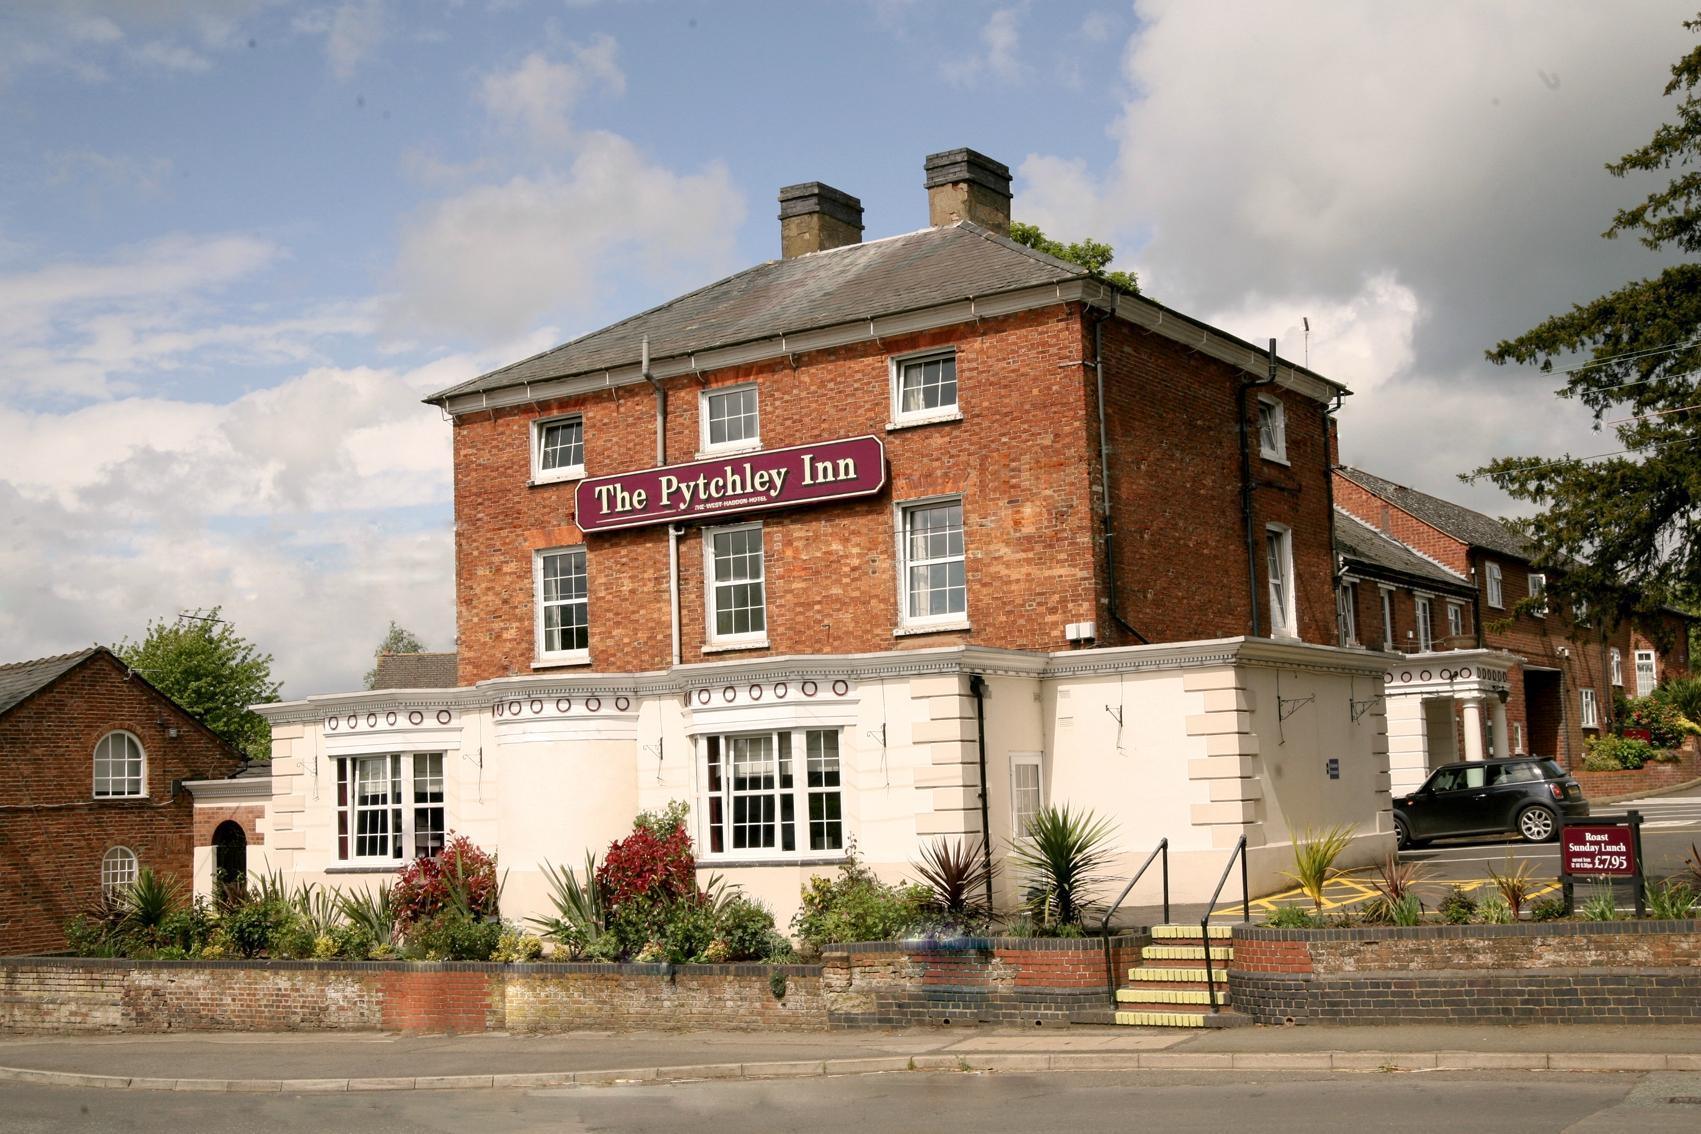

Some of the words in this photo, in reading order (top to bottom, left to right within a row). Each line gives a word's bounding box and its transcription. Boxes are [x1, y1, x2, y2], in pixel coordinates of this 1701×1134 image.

[595, 483, 647, 514] The
[659, 463, 788, 509] Pytchley
[801, 454, 857, 485] Inn
[1584, 832, 1609, 841] Roast
[1568, 842, 1600, 854] Sunday
[1601, 842, 1627, 852] Lunch
[1594, 855, 1627, 869] £7.95
